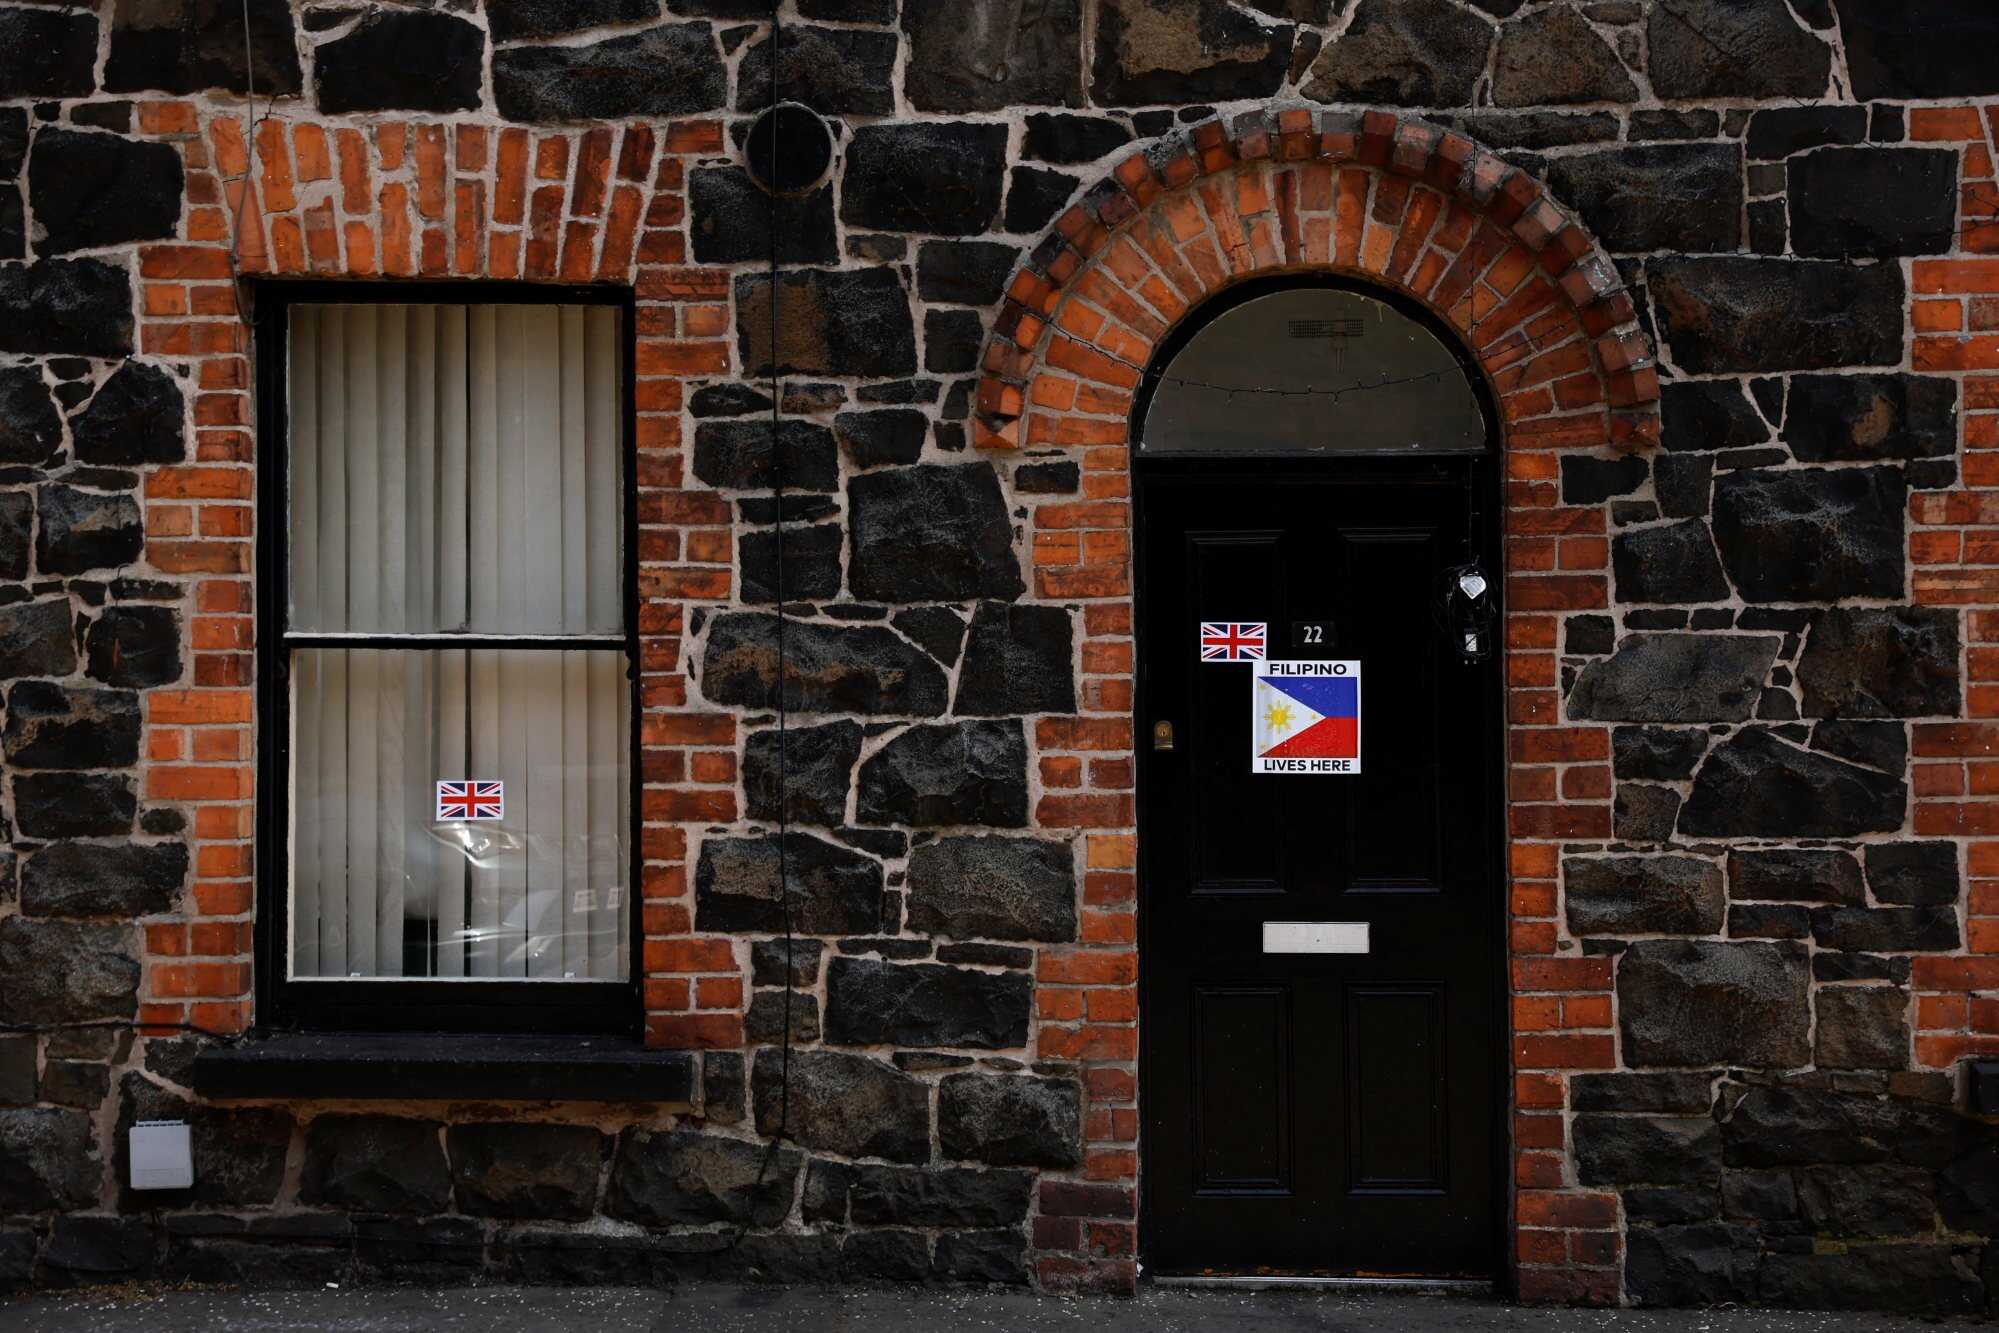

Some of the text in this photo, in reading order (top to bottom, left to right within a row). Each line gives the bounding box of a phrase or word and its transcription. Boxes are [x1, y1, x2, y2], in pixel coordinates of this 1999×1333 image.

[1303, 626, 1323, 643] 22
[1269, 664, 1347, 675] FILIPINO
[1264, 760, 1351, 771] LIVES HERE
